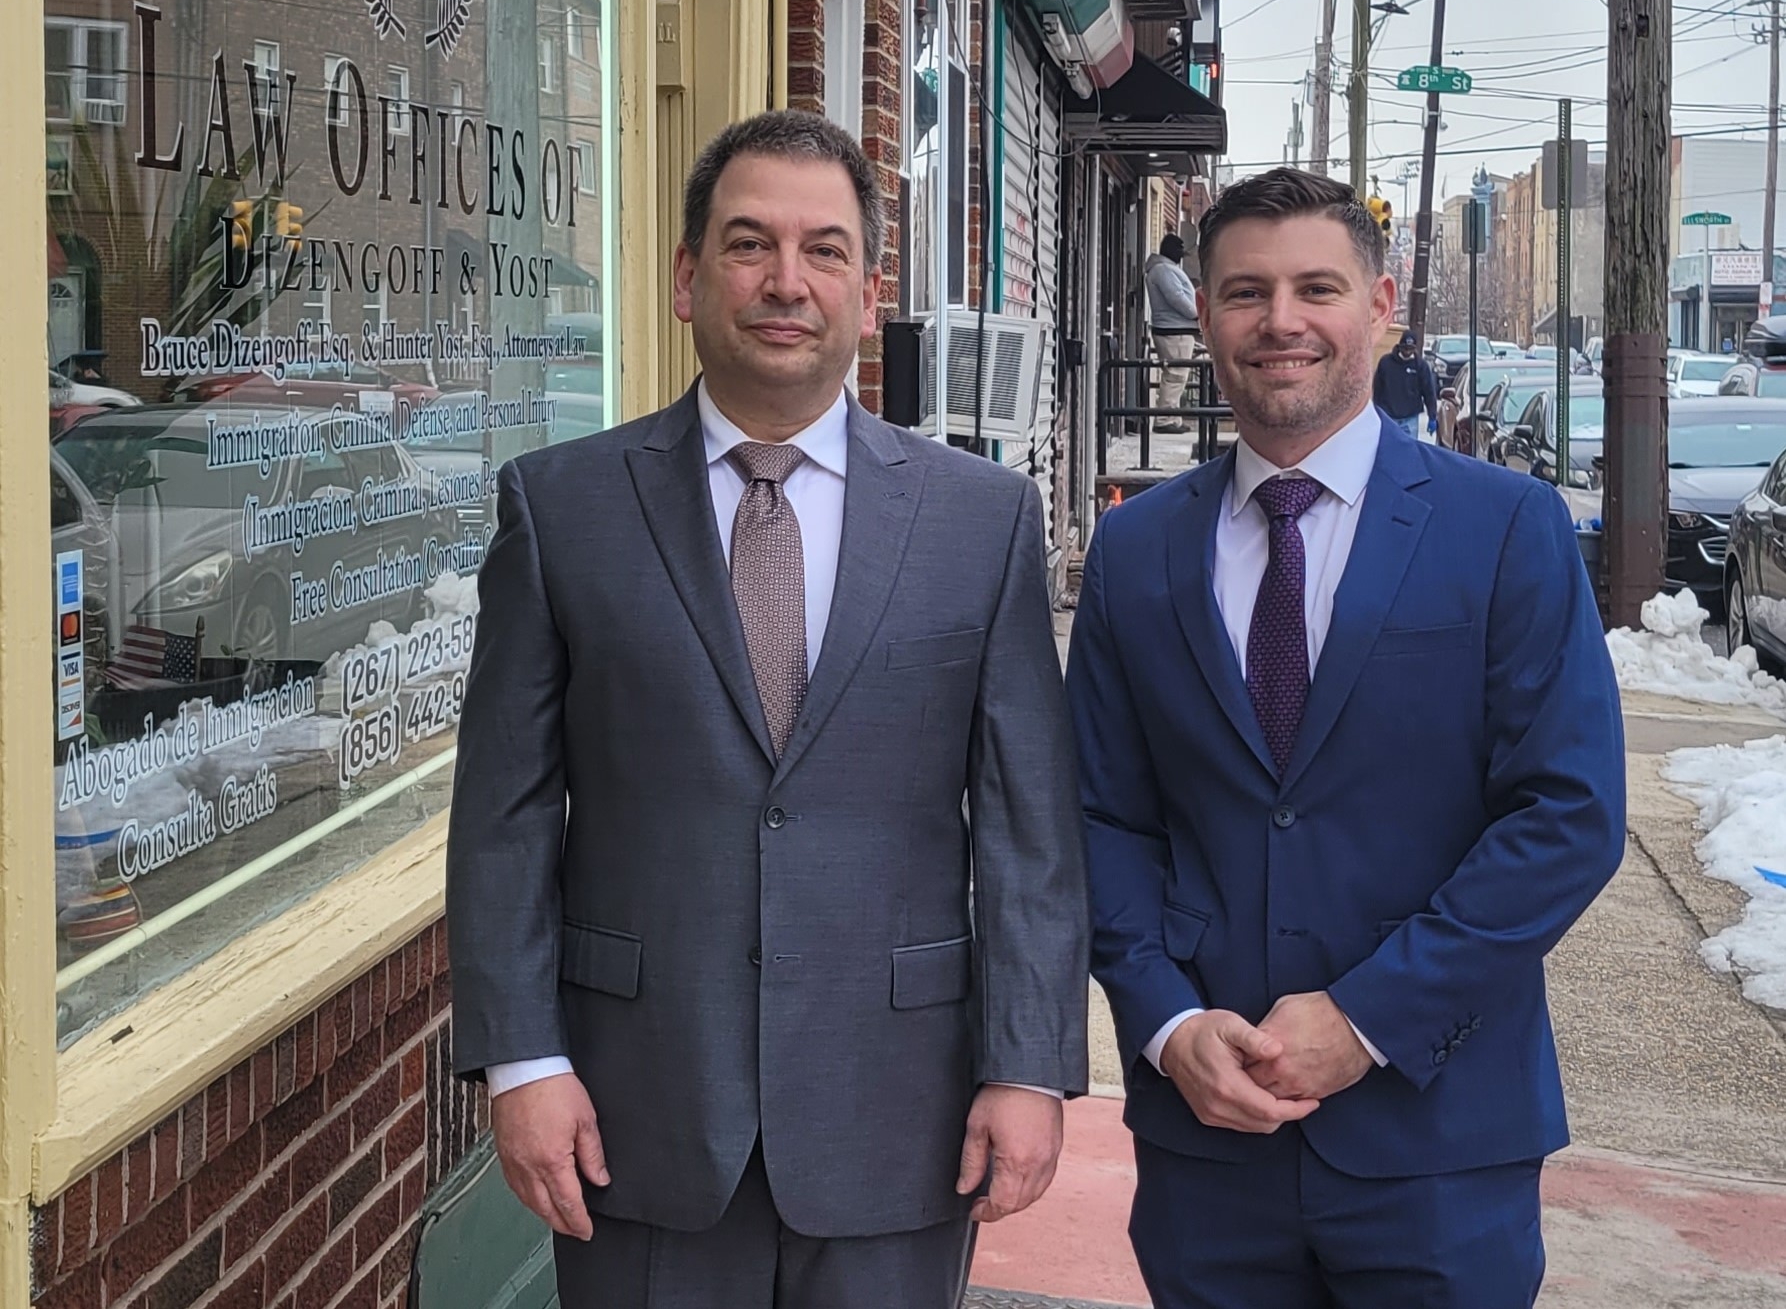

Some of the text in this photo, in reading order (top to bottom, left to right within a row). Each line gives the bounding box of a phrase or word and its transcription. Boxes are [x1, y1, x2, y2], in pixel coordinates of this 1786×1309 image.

[132, 0, 581, 228] LAW OFFICES OF
[1418, 73, 1469, 90] 8th St
[219, 216, 553, 299] DIZENGOFF & YOST
[142, 322, 209, 372] Bruce
[213, 321, 315, 380] Dizengoff,
[318, 322, 355, 377] Esq.
[361, 321, 379, 362] &
[380, 321, 433, 361] Hunter
[435, 323, 468, 367] Yost,
[501, 323, 552, 368] Attorneys
[553, 333, 565, 357] at
[565, 325, 586, 359] Law
[207, 390, 558, 477] Immigration, Criminal Defense, and Personal Injury
[242, 486, 358, 562] (Inmigracion,
[360, 468, 426, 526] Criminal,
[429, 466, 481, 509] Lesiones
[291, 573, 327, 623] Free
[63, 661, 80, 677] VISA
[342, 614, 474, 716] (267) 223-58
[60, 672, 315, 806] Abogado de Inmigracion
[340, 704, 400, 782] (856)
[119, 764, 276, 879] Consulta Gratis
